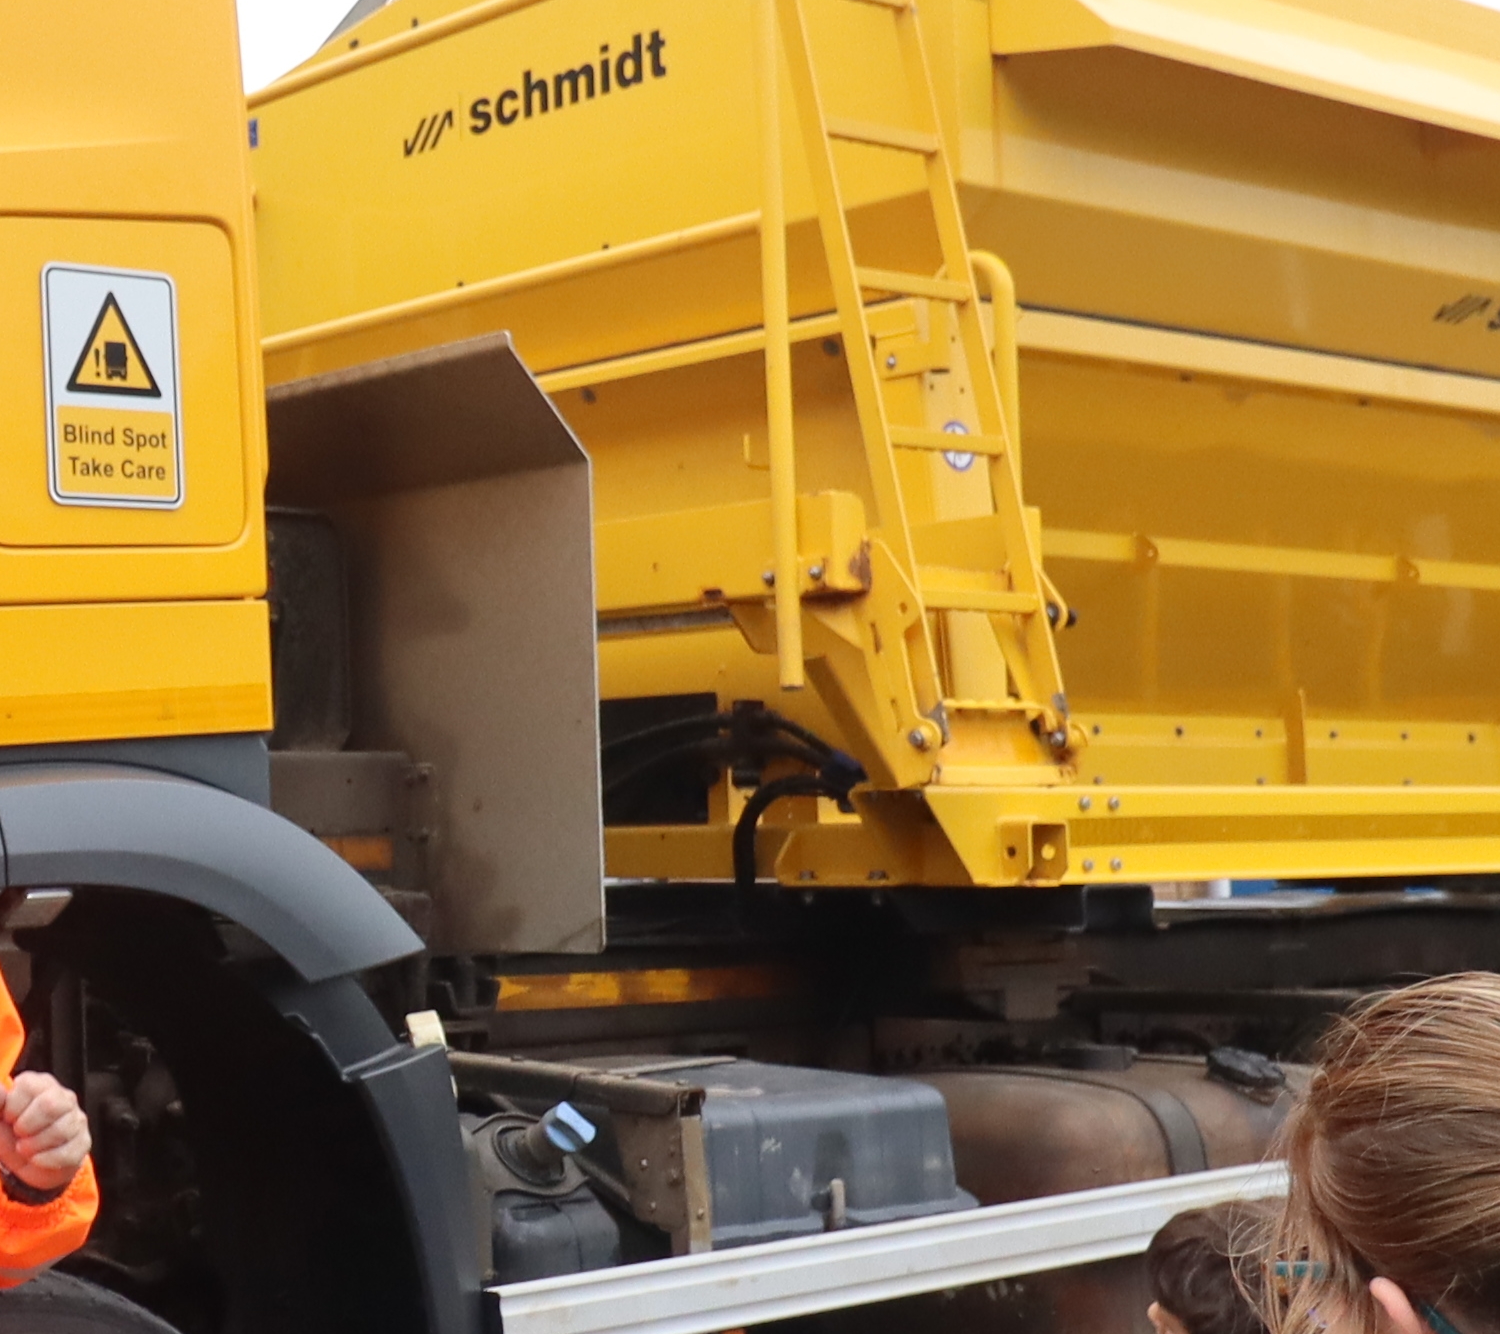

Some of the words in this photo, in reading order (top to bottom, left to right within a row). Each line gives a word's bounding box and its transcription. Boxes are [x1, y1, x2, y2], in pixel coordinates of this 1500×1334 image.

[469, 30, 666, 135] schmidt
[63, 423, 116, 446] Blind
[122, 427, 168, 453] Spot
[68, 455, 115, 478] Take
[121, 459, 166, 481] Care
